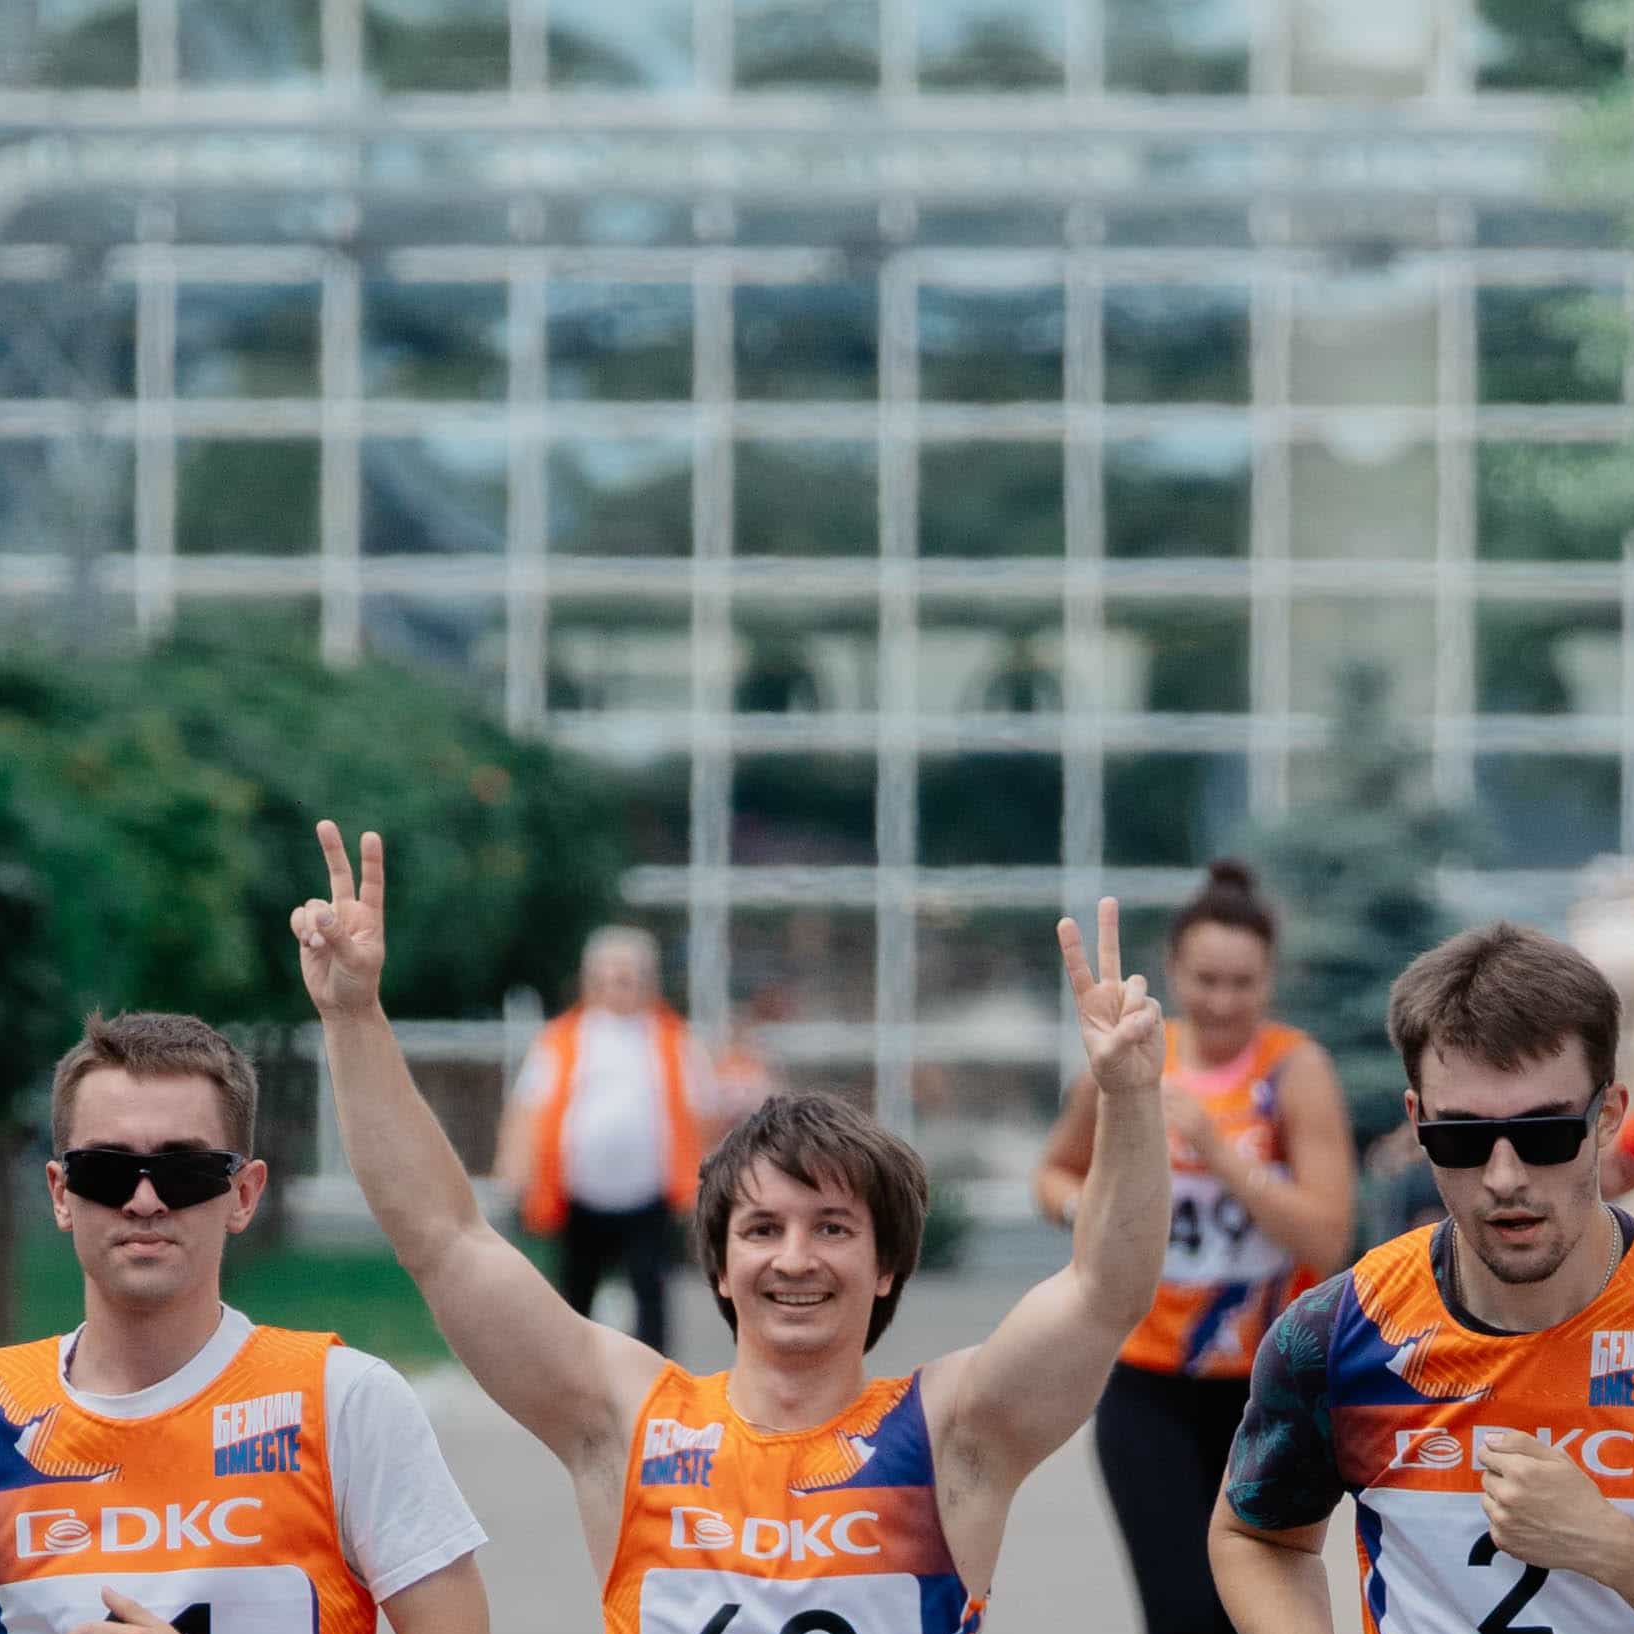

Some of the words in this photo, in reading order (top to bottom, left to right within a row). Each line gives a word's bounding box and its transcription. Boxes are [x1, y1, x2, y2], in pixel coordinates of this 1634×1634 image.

[213, 1391, 302, 1450] БЕЖИМ
[214, 1424, 301, 1477] ВМЕСТЕ
[100, 1496, 263, 1553] DKC
[740, 1510, 881, 1562] DKC
